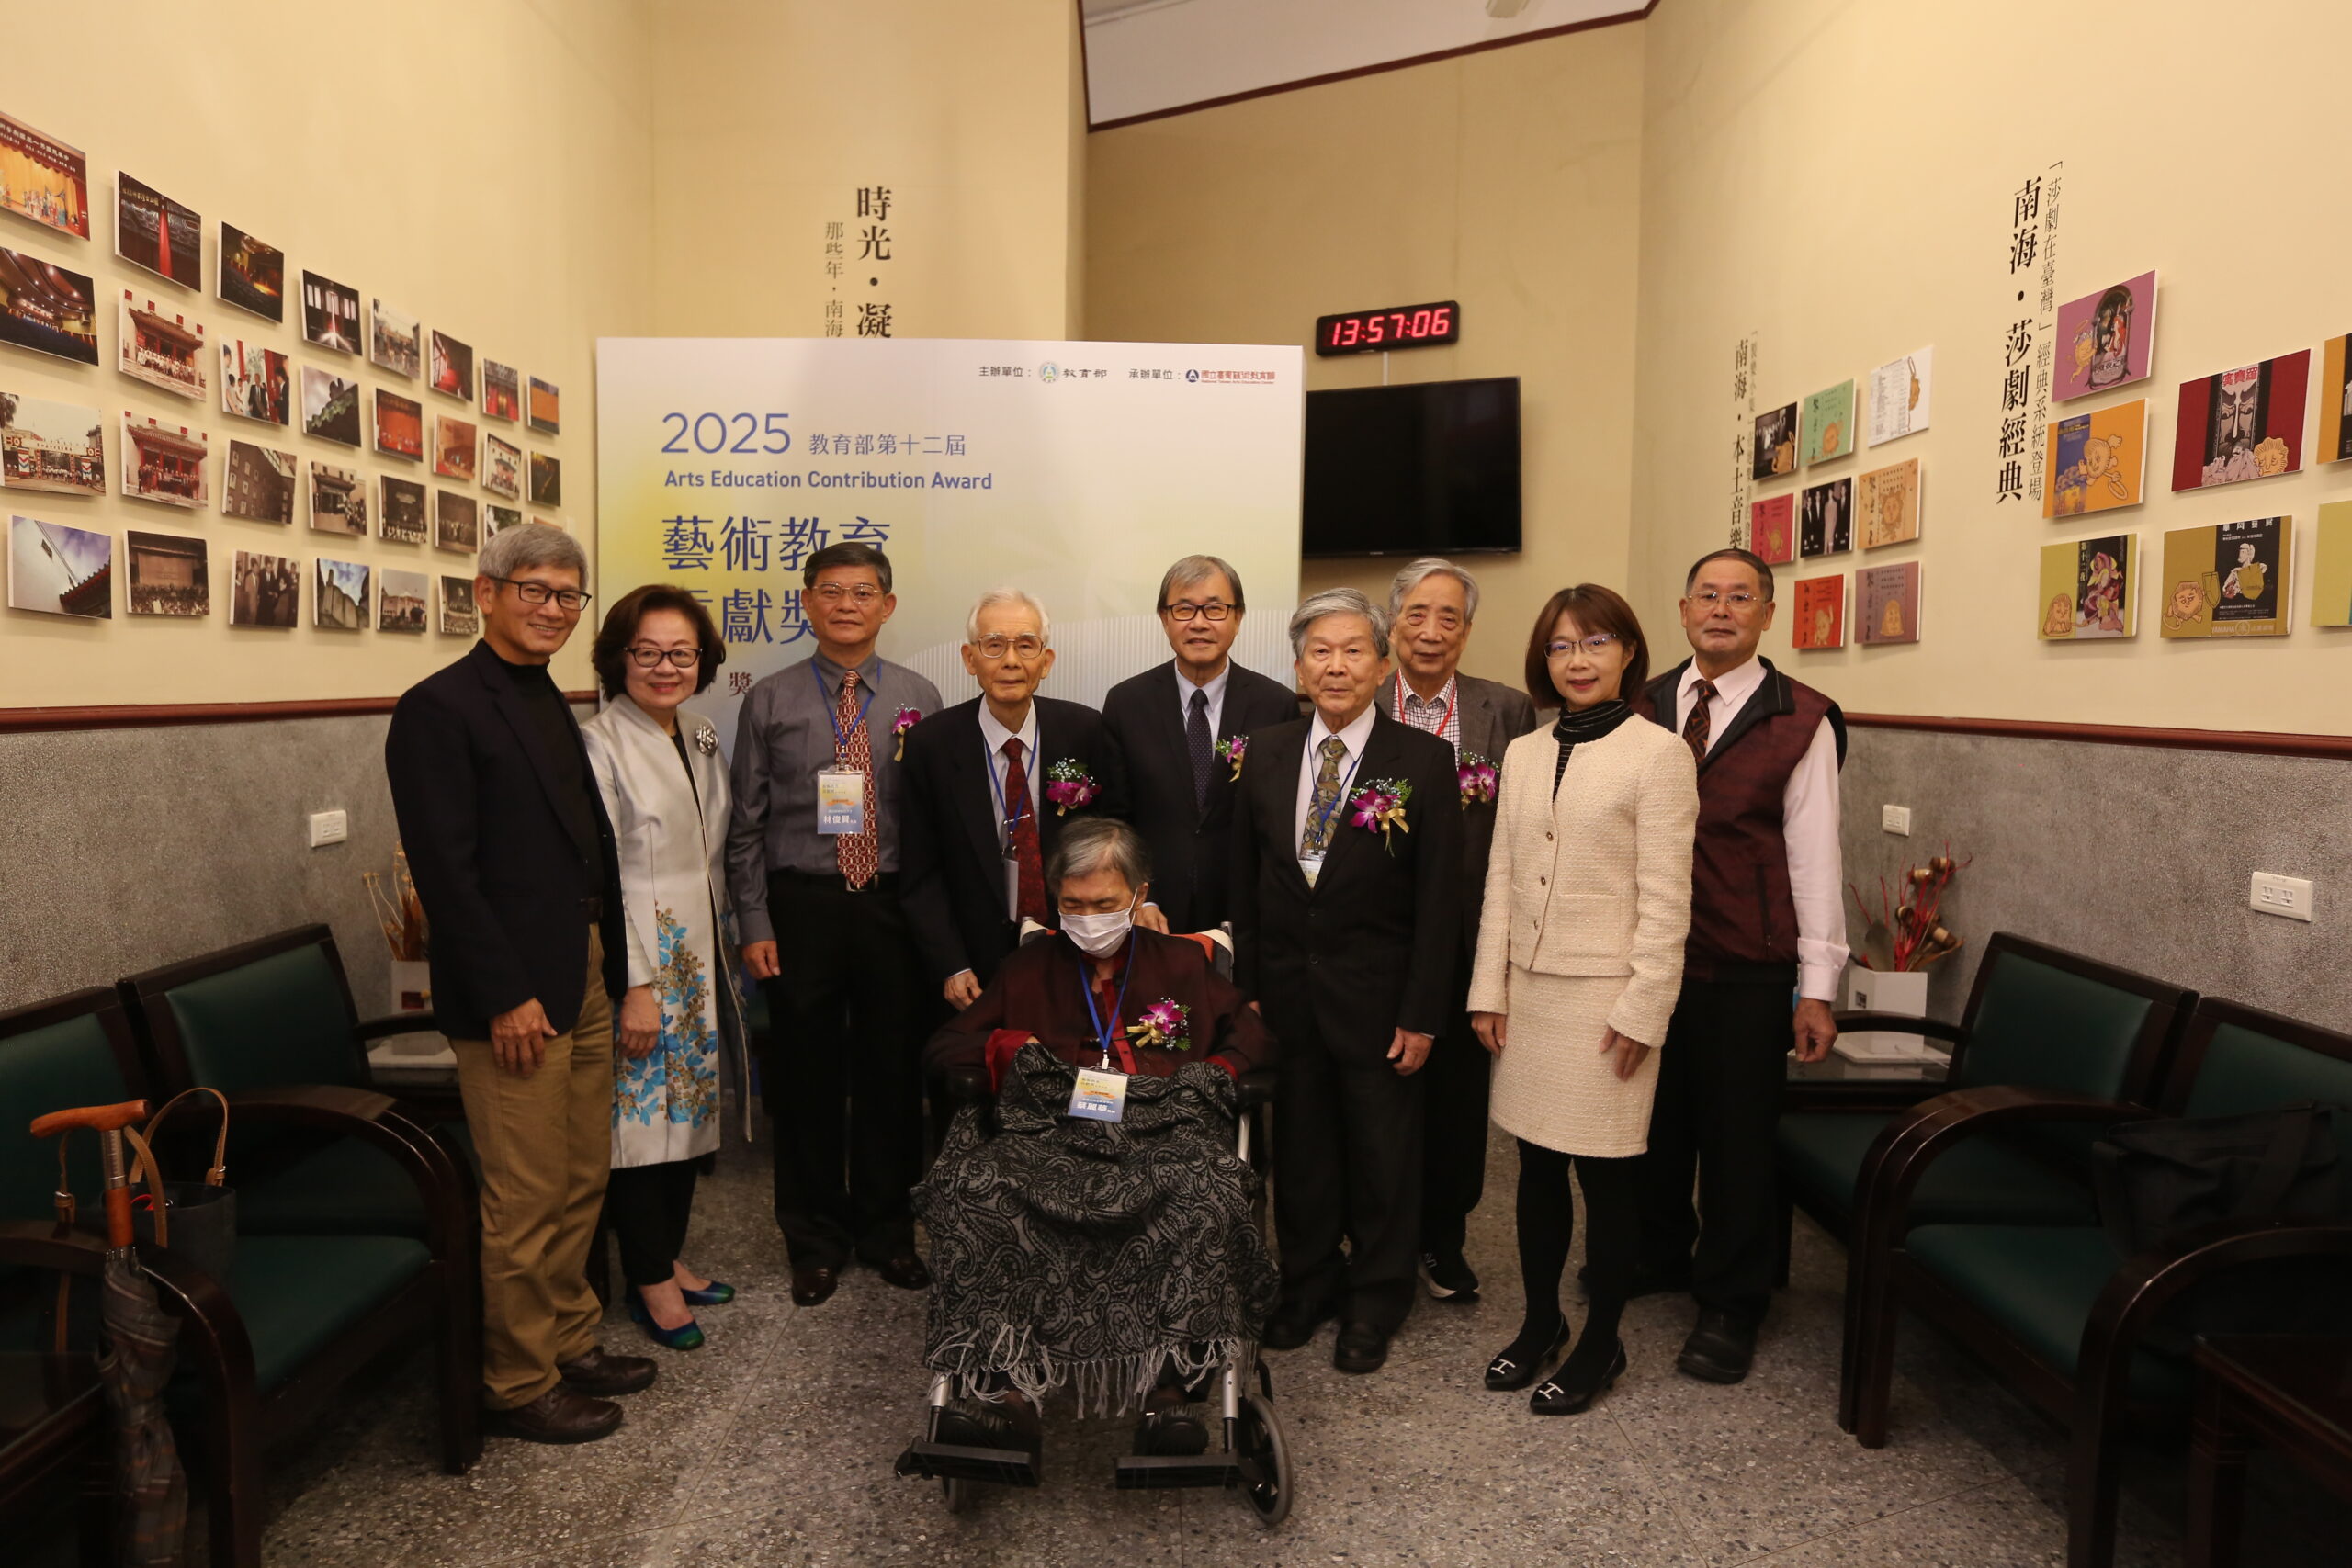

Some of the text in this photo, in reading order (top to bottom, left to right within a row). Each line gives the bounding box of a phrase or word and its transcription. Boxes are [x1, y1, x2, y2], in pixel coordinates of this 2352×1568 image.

[1332, 308, 1450, 346] 13:57:06
[1063, 368, 1108, 379] 教育部
[662, 412, 791, 454] 2025
[808, 434, 966, 457] 教育部第十二屆
[664, 470, 993, 490] Arts Education Contribution Award
